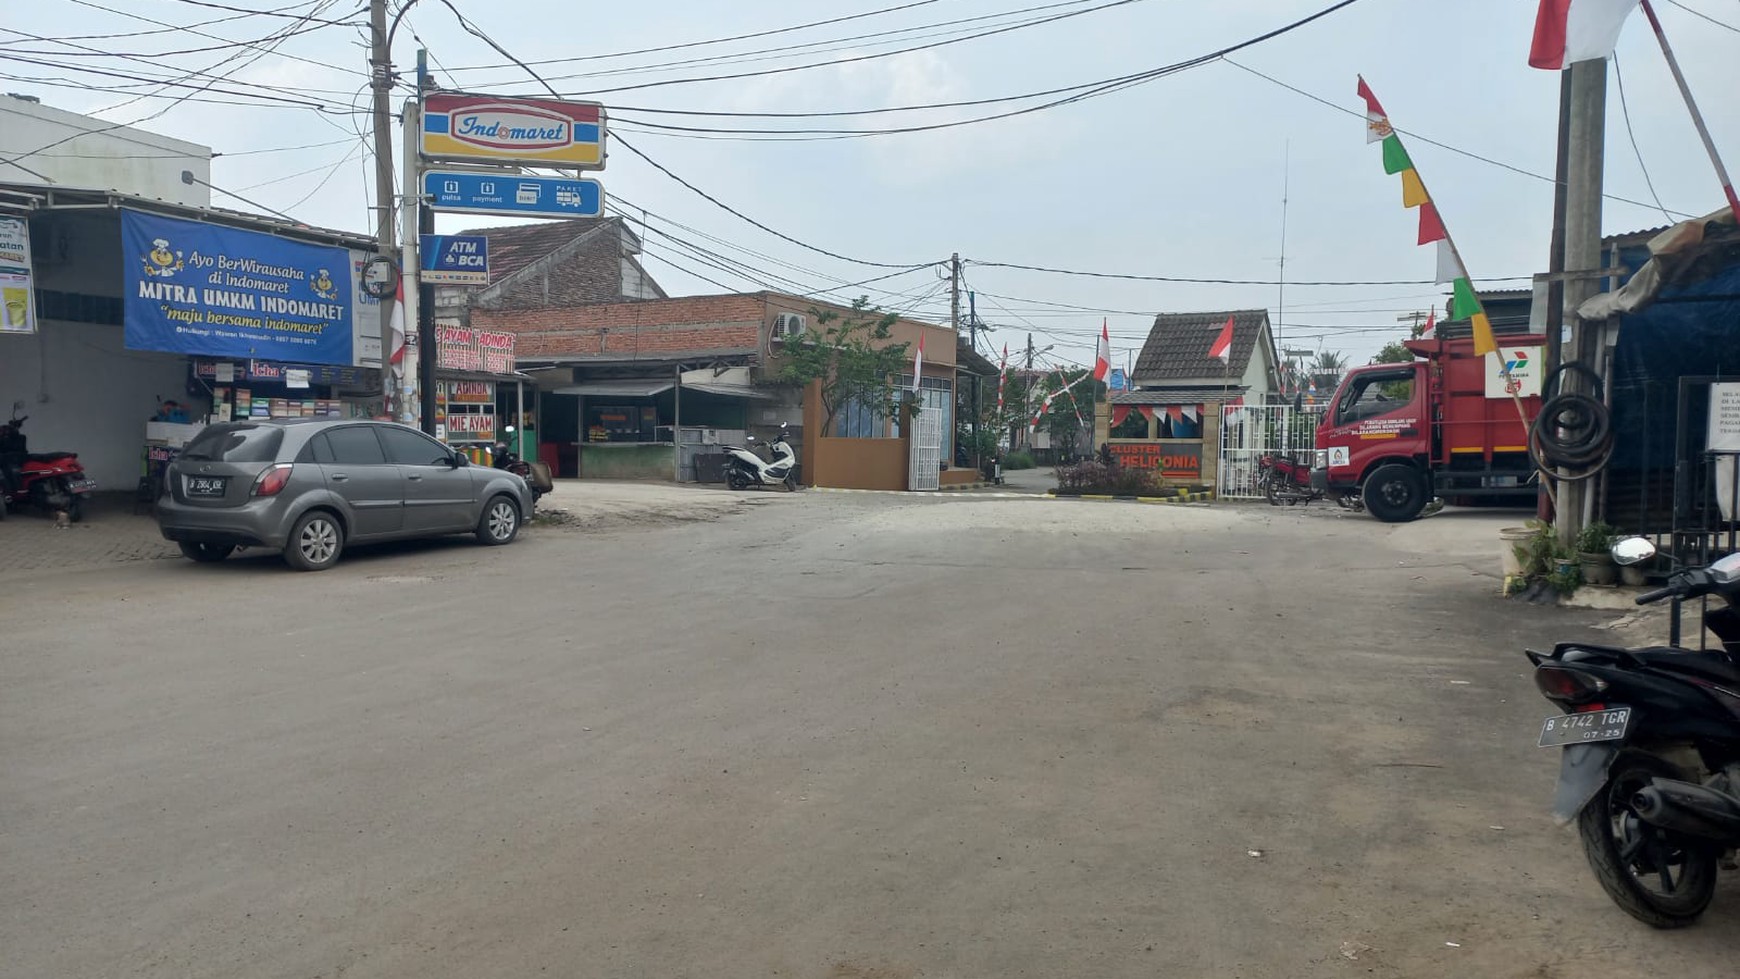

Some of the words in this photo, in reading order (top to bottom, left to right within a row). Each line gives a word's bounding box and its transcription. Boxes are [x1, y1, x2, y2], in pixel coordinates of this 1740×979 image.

[458, 116, 563, 140] Indomaret
[441, 194, 462, 202] pulsa
[472, 196, 503, 204] payment
[449, 241, 477, 253] ATM
[189, 251, 214, 268] Ayo
[218, 255, 304, 280] BerWirausaha
[458, 255, 484, 266] BCA
[208, 272, 222, 284] di
[226, 273, 290, 294] Indomaret
[139, 280, 198, 304] MITRA
[203, 288, 255, 311] UMKM
[261, 296, 344, 320] INDOMARET
[207, 311, 261, 329] bersama
[444, 328, 473, 344] AYAM
[456, 381, 488, 395] ADINDA
[449, 416, 466, 431] MIE
[470, 416, 493, 431] AYAM
[1109, 445, 1160, 454] CLUSTER
[1546, 719, 1555, 731] B
[1561, 715, 1594, 729] 4742
[1601, 710, 1626, 725] TGR
